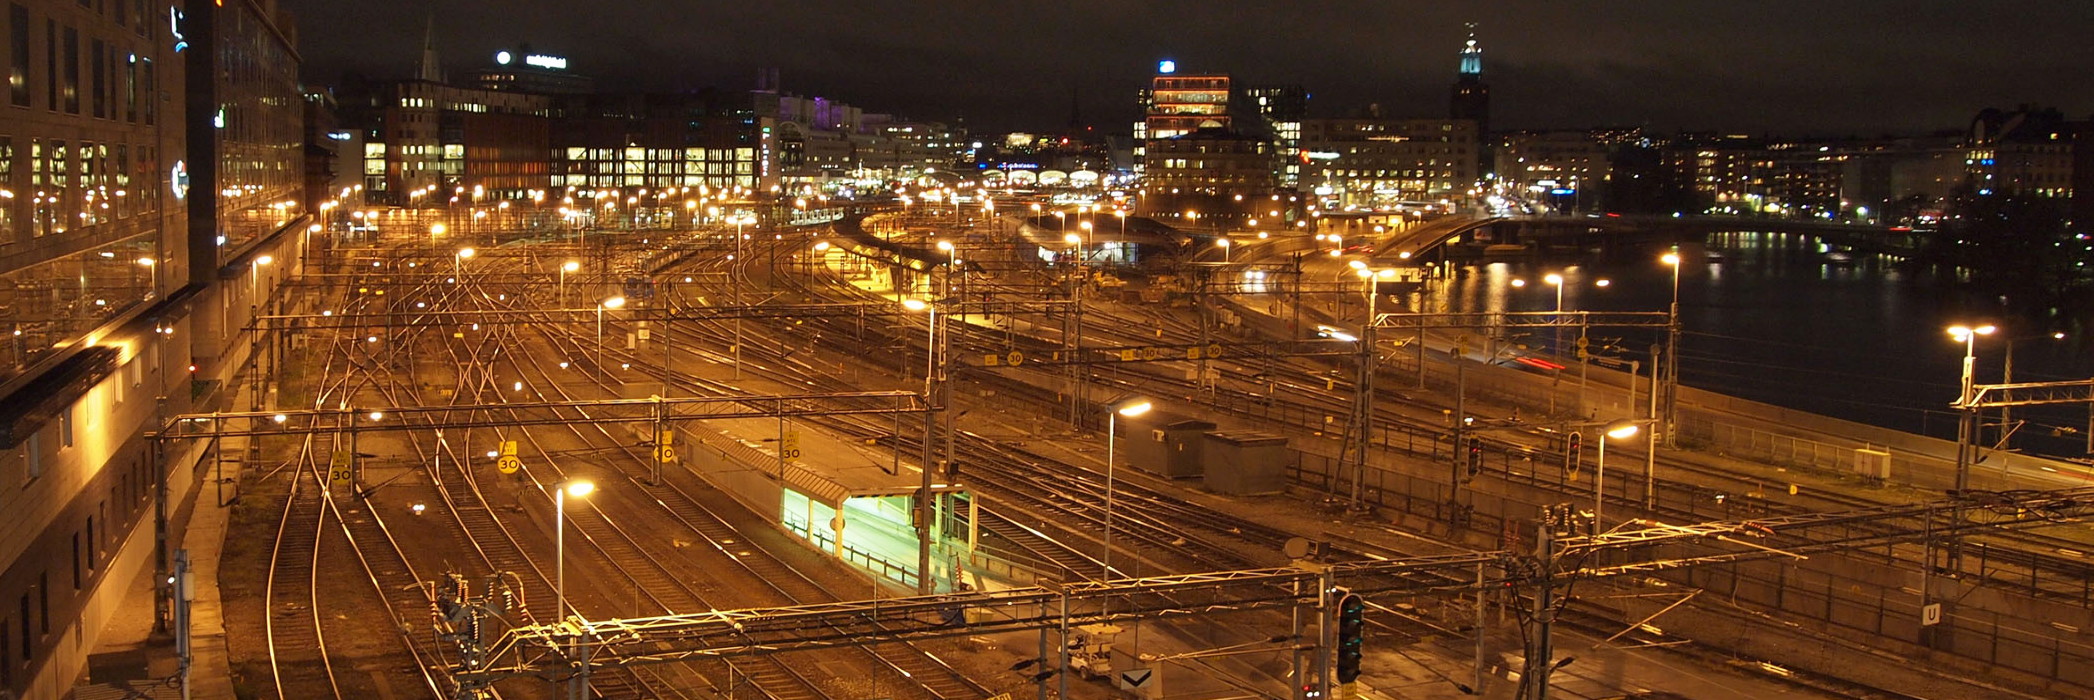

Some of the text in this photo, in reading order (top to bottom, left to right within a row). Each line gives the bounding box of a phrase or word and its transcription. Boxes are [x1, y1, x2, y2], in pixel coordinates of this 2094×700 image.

[1010, 354, 1021, 363] 30
[784, 449, 800, 459] 30
[500, 460, 518, 470] 30
[332, 470, 351, 480] 30
[1928, 608, 1936, 621] U
